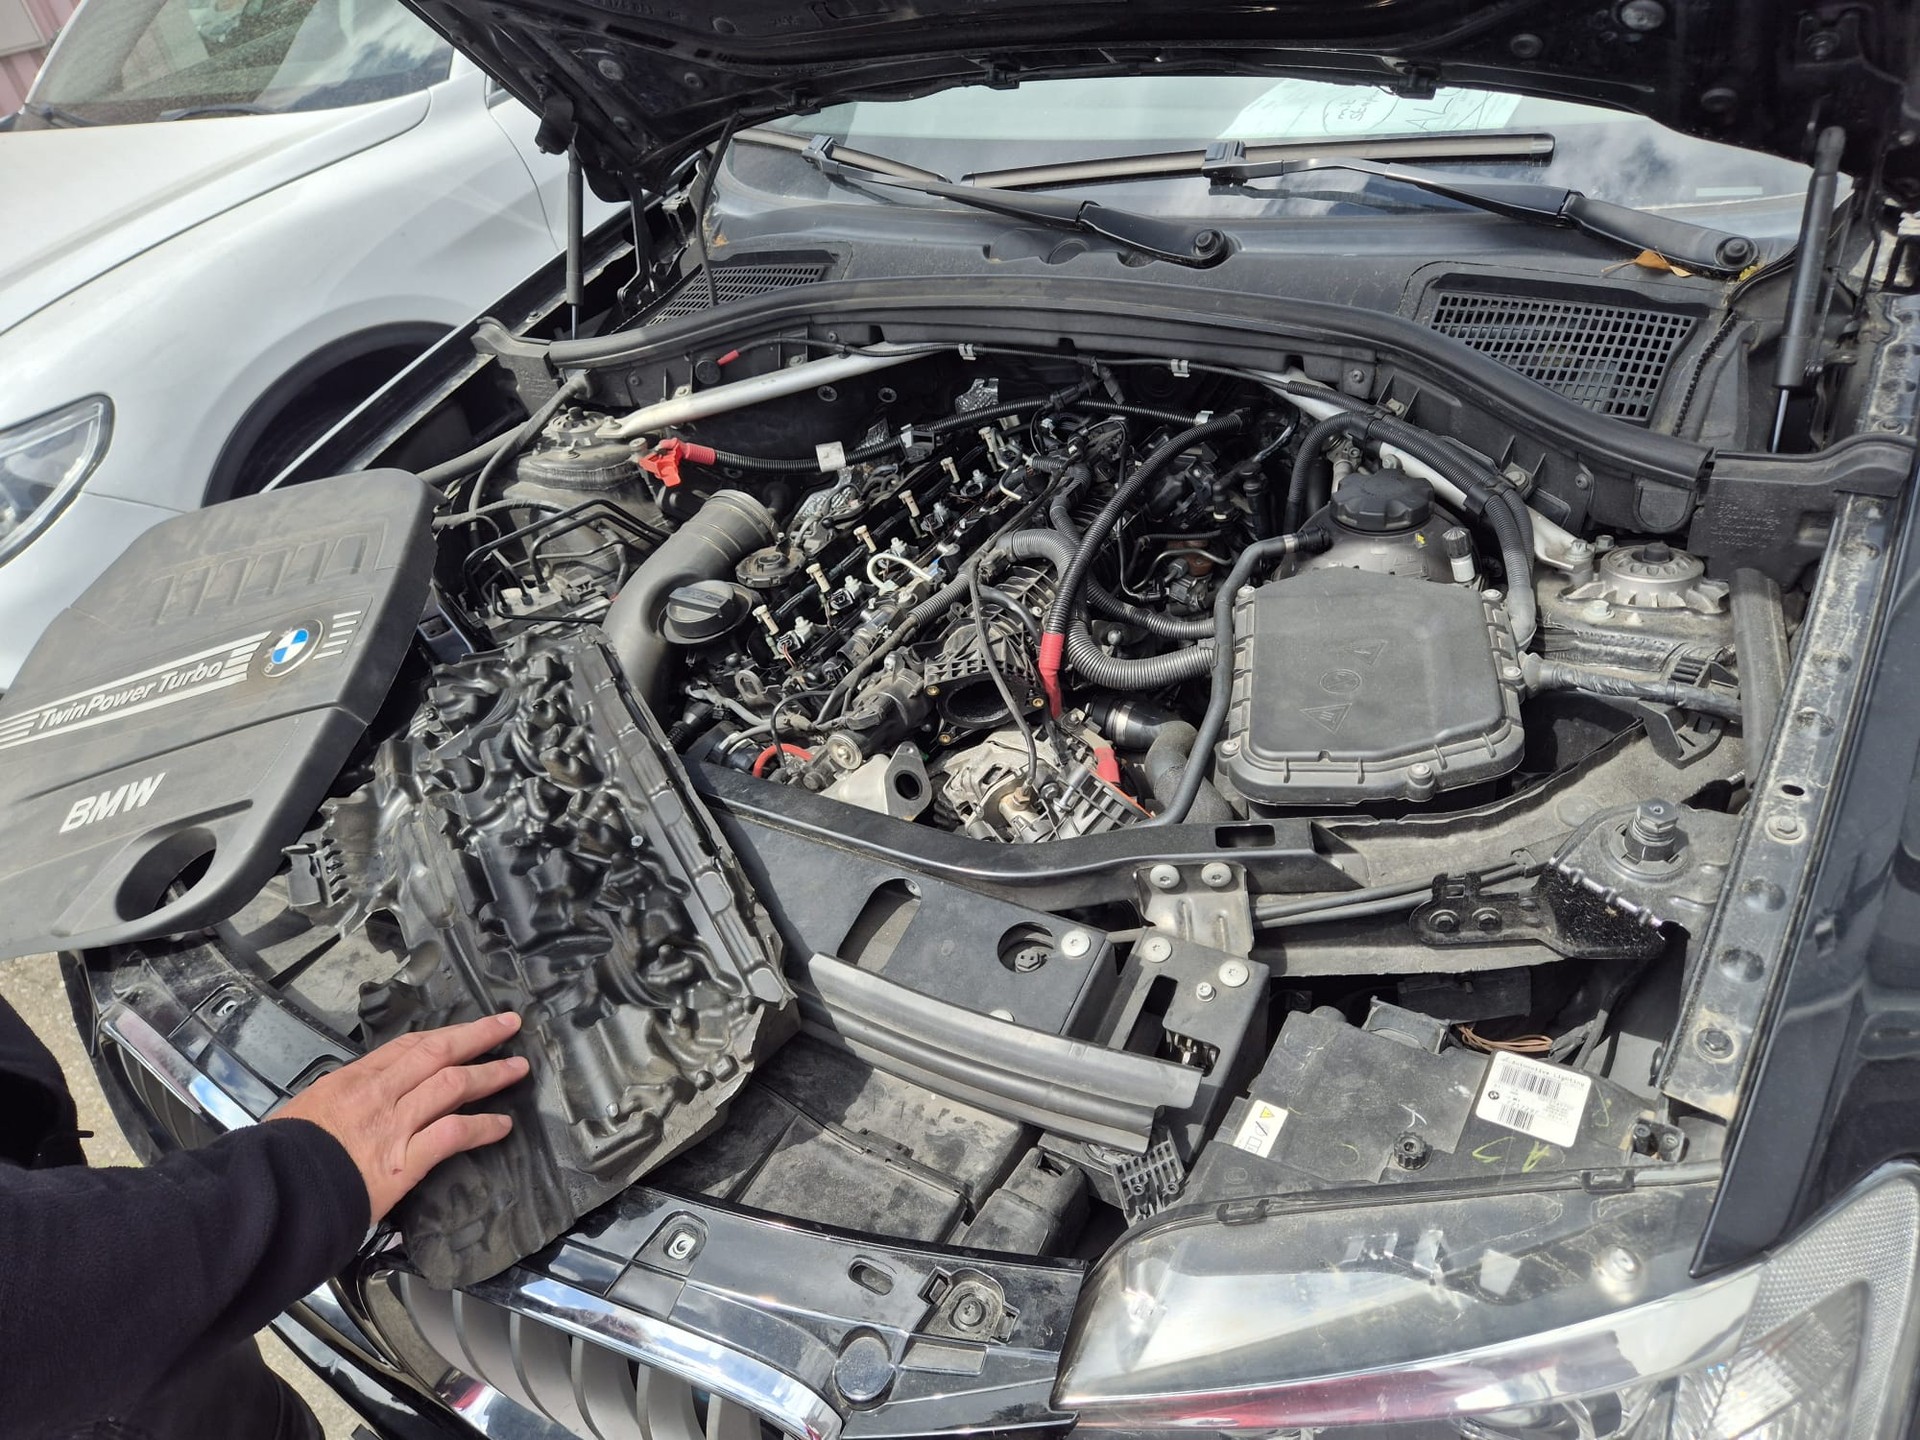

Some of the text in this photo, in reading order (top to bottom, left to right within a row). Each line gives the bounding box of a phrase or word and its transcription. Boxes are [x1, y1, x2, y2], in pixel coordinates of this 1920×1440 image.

[38, 661, 223, 730] TwinPower Turbo
[59, 772, 167, 833] BMW
